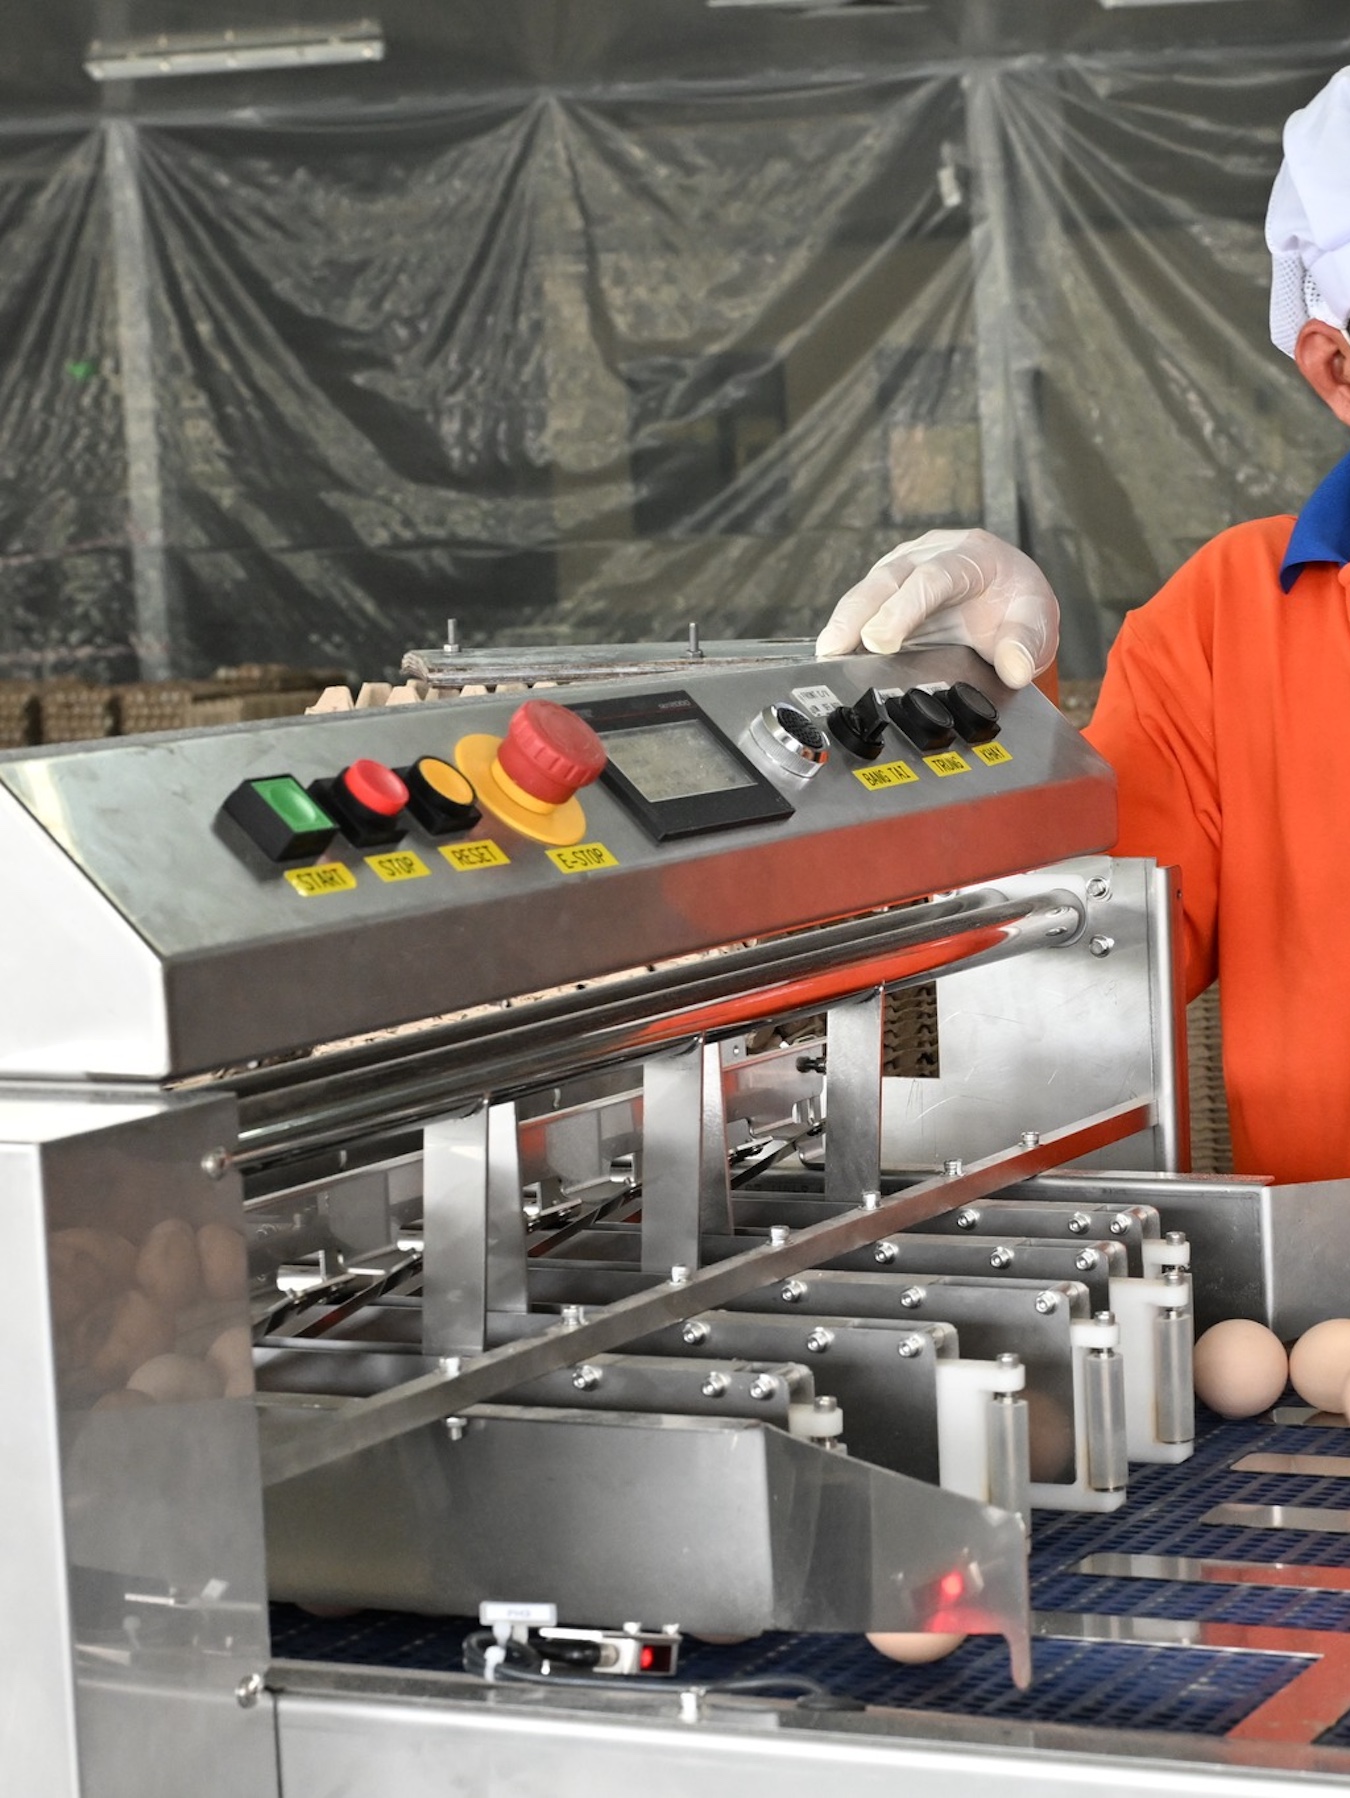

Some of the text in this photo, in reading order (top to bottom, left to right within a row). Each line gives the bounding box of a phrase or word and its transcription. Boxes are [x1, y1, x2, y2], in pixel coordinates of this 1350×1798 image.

[981, 746, 1006, 762] KHAY
[862, 765, 912, 787] BANG TAI
[451, 845, 498, 866] RESET
[556, 848, 604, 870] E-STOP
[378, 856, 416, 877] STOP
[296, 868, 347, 891] START
